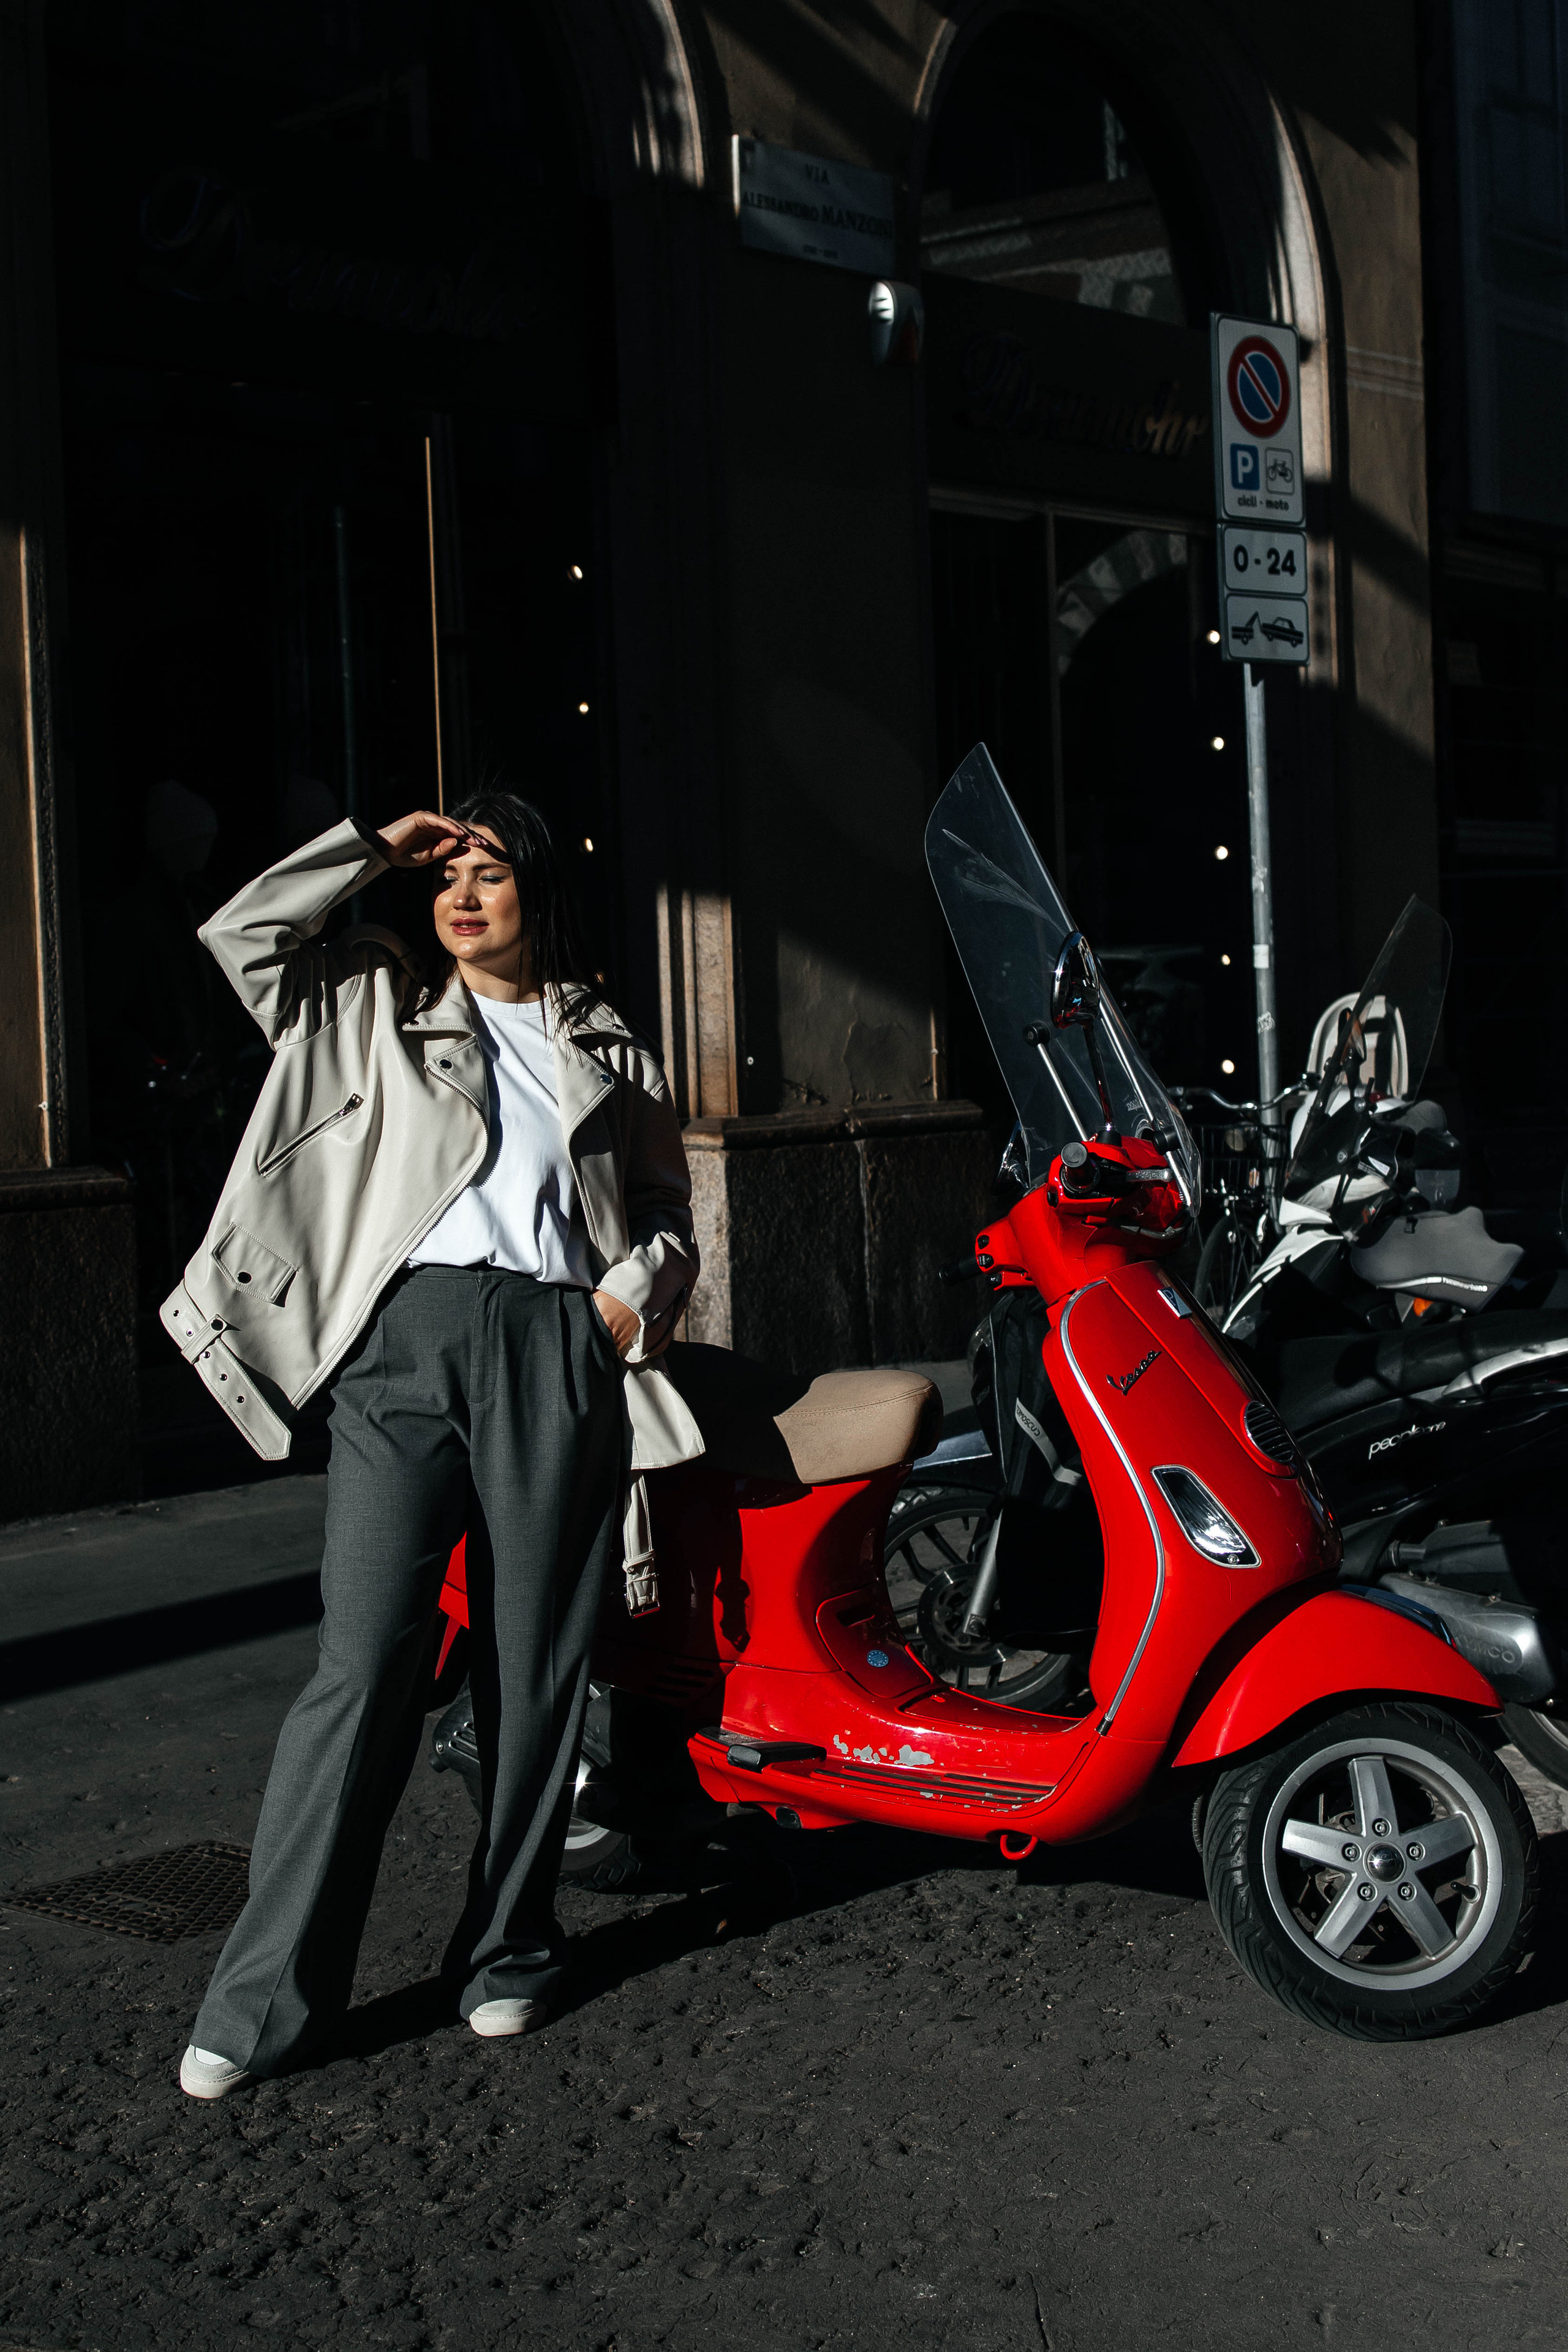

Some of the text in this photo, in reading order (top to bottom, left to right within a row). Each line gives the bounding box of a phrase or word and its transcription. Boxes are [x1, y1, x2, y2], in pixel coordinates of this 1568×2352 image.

[805, 164, 830, 184] VIA
[742, 191, 894, 239] ALESSANDRO MANZONI
[954, 331, 1211, 457] Drumohr
[1237, 450, 1254, 484] P
[1238, 494, 1257, 508] cicli
[1265, 499, 1289, 511] moto
[1233, 544, 1249, 573] 0
[1266, 547, 1297, 576] 24
[1105, 1349, 1163, 1396] Vespa
